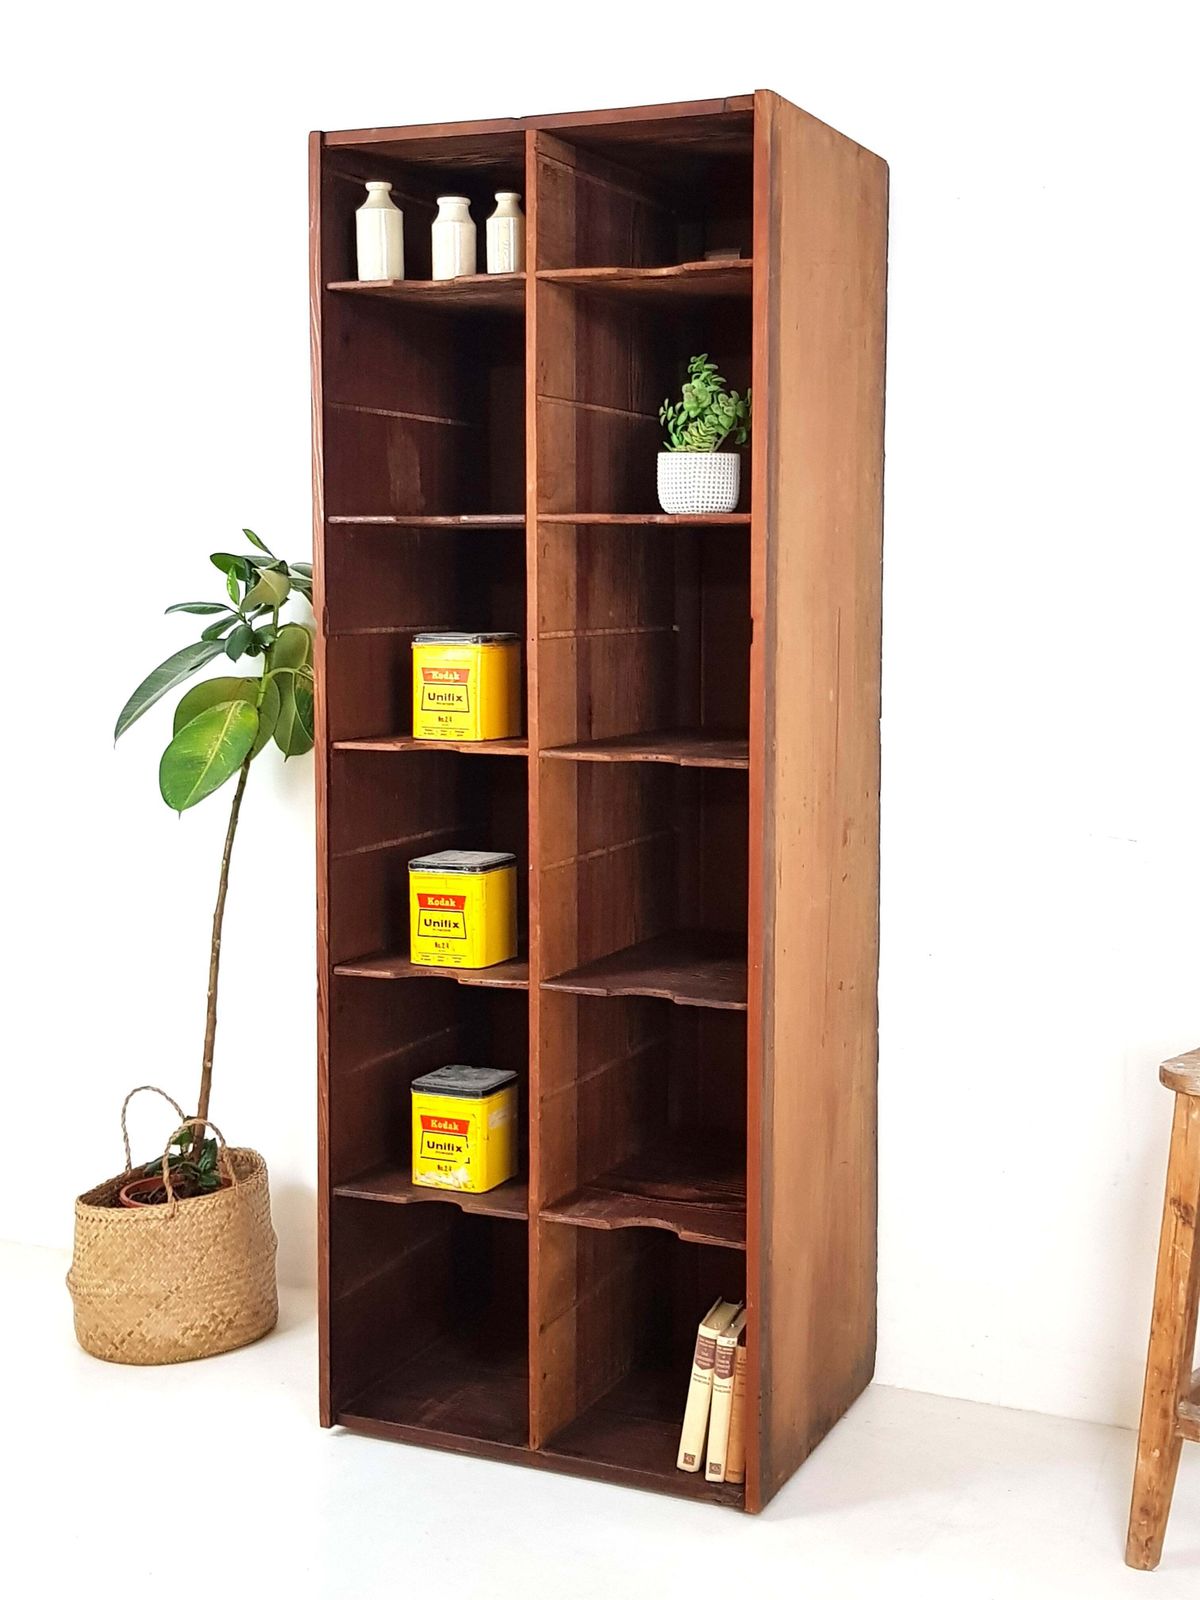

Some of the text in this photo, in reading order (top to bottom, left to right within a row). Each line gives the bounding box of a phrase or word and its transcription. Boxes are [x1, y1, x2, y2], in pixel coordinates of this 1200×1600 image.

[431, 670, 460, 680] Kodak
[427, 692, 463, 702] Unifix
[427, 897, 456, 907] Kodak
[424, 918, 459, 929] Unifix
[430, 1119, 459, 1131] Kodak
[427, 1140, 462, 1153] Unifix
